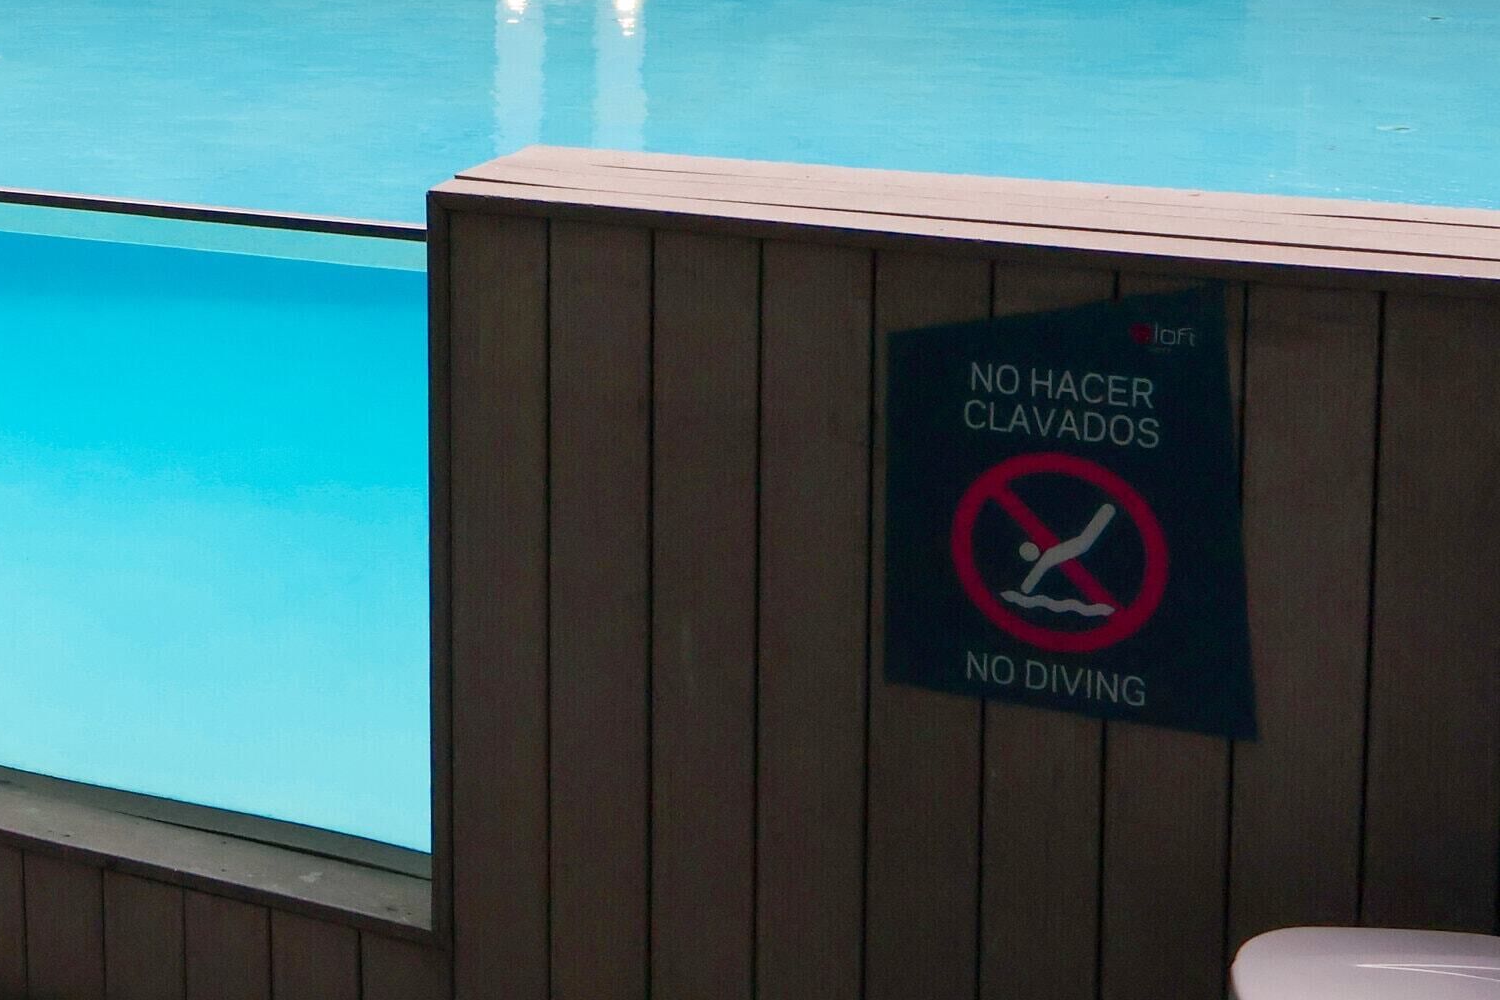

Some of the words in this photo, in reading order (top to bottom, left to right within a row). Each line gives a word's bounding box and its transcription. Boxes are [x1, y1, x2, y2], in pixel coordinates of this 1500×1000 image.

[971, 362, 1020, 395] NO
[1031, 367, 1154, 409] HACER
[964, 399, 1160, 449] CLAVADOS
[966, 650, 1014, 685] NO
[1025, 659, 1146, 706] DIVING
